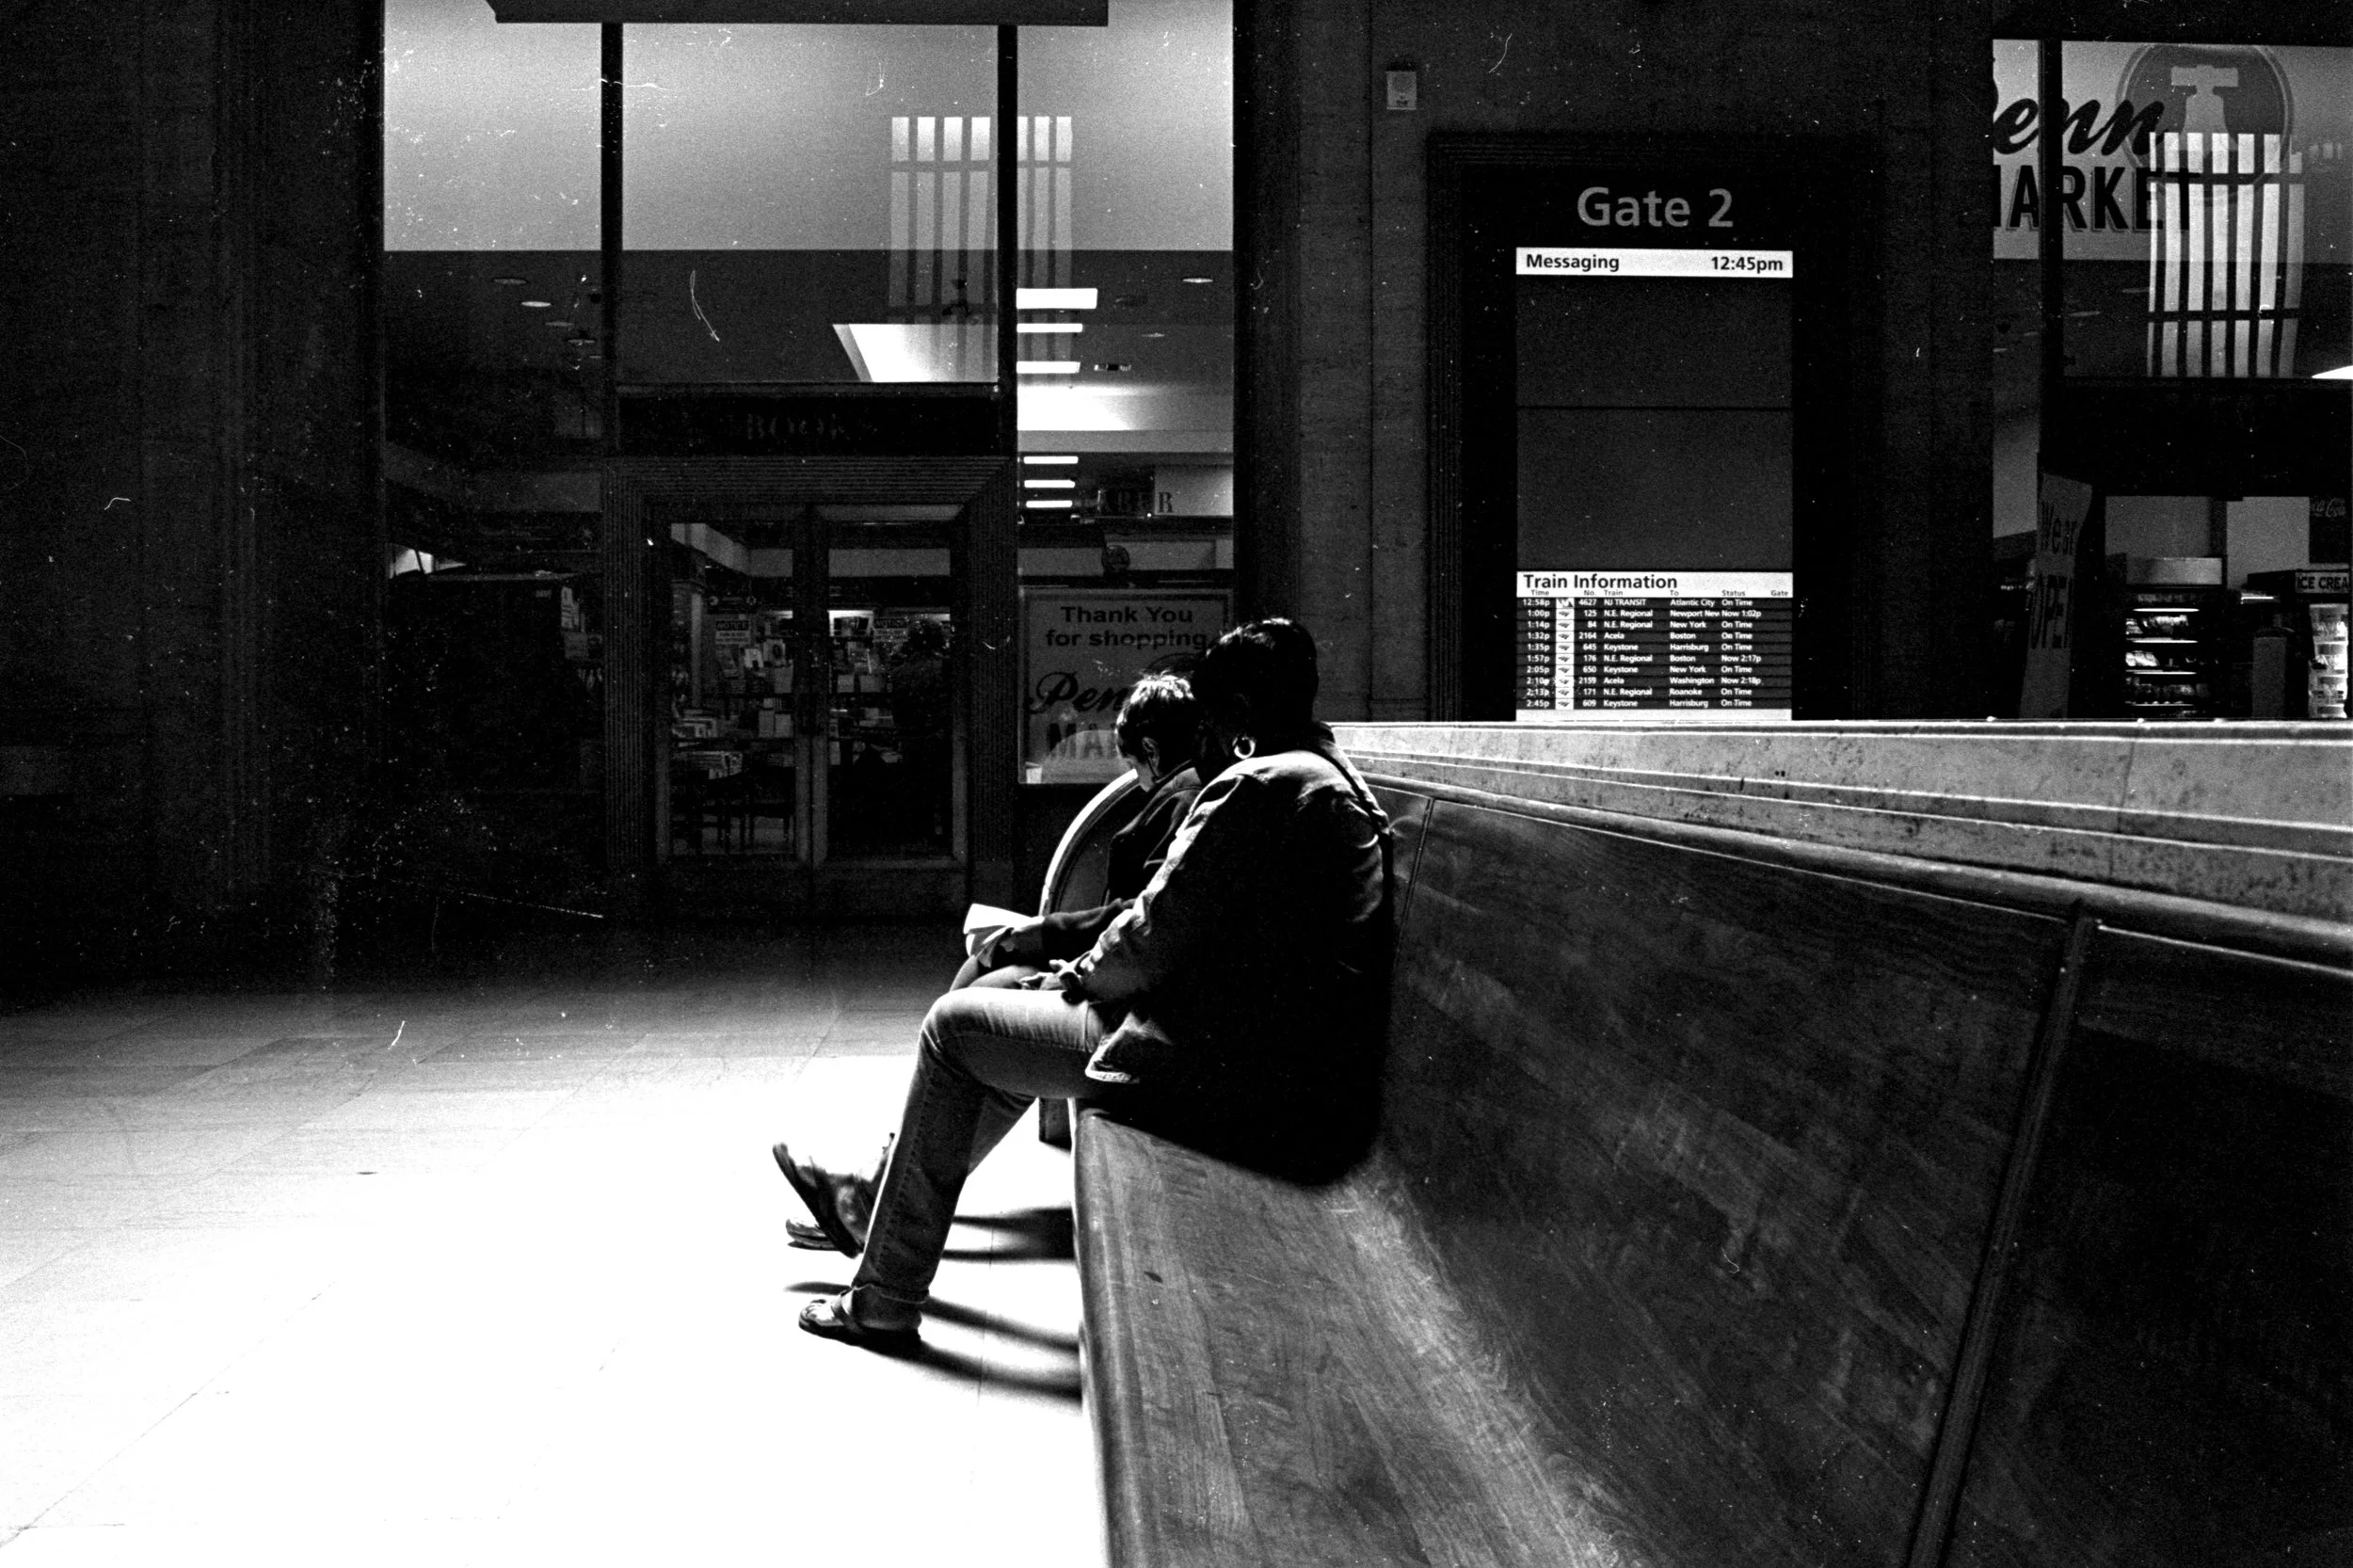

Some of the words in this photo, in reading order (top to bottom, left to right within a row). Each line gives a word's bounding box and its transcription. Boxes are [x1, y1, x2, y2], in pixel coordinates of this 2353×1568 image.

[1993, 98, 2170, 155] enn
[1577, 186, 1691, 228] Gate
[1708, 188, 1734, 228] 2
[1526, 253, 1620, 273] Messaging
[1711, 256, 1784, 275] 12:45pm
[1523, 573, 1568, 589] Train
[1574, 573, 1677, 589] Information
[2318, 576, 2348, 590] CREA
[1522, 598, 1551, 607] 12:58p
[1577, 598, 1597, 606] 4627
[1614, 598, 1647, 606] TRANSIT
[1700, 598, 1716, 607] City
[1060, 605, 1138, 624] Thank
[1145, 606, 1193, 624] You
[1527, 609, 1551, 618] 1:00p
[1583, 609, 1597, 617] 125
[1603, 609, 1619, 617] N.E.
[1620, 609, 1654, 618] Regional
[1669, 609, 1704, 618] Newport
[1721, 609, 1740, 617] Now
[1741, 609, 1762, 618] 1:02p
[1527, 620, 1551, 630] 1:14p
[1587, 620, 1597, 629] 84
[1603, 620, 1619, 629] N.E.
[1619, 620, 1654, 630] Regional
[1669, 620, 1689, 629] New
[1689, 620, 1707, 629] York
[1721, 620, 1734, 629] On
[1734, 620, 1753, 629] Time
[1046, 629, 1081, 647] for
[1089, 629, 1208, 650] shopping
[1527, 632, 1551, 641] 1:32p
[1578, 632, 1597, 640] 2164
[1603, 632, 1625, 640] Acela
[1669, 632, 1697, 640] Boston
[1734, 632, 1753, 640] Time
[1527, 643, 1550, 652] 1:35p
[1603, 643, 1640, 652] Keystone
[1669, 643, 1710, 652] Harrisburg
[1721, 643, 1734, 651] On
[1734, 643, 1753, 651] Time
[1527, 654, 1550, 664] 1:57p
[1603, 654, 1619, 663] N.E.
[1619, 654, 1654, 664] Regional
[1669, 654, 1697, 663] Boston
[1721, 654, 1740, 663] Now
[1740, 654, 1762, 664] 2:17p
[1526, 664, 1550, 674] 2:05p
[1603, 665, 1639, 675] Keystone
[1669, 665, 1688, 674] New
[1689, 664, 1707, 674] York
[1721, 664, 1734, 674] On
[1734, 664, 1753, 674] Time
[1603, 676, 1625, 685] Acela
[1669, 677, 1715, 686] Washington
[1739, 676, 1762, 685] 2:18p
[1026, 671, 1129, 712] Pen
[1603, 687, 1618, 696] N.E.
[1619, 687, 1653, 696] Regional
[1668, 687, 1703, 696] Roanoke
[1720, 687, 1734, 696] On
[1734, 687, 1753, 696] Time
[1526, 698, 1550, 708] 2:45p
[1603, 699, 1639, 709] Keystone
[1669, 698, 1709, 709] Harrisburg
[1721, 698, 1733, 707] On
[1734, 698, 1753, 707] Time
